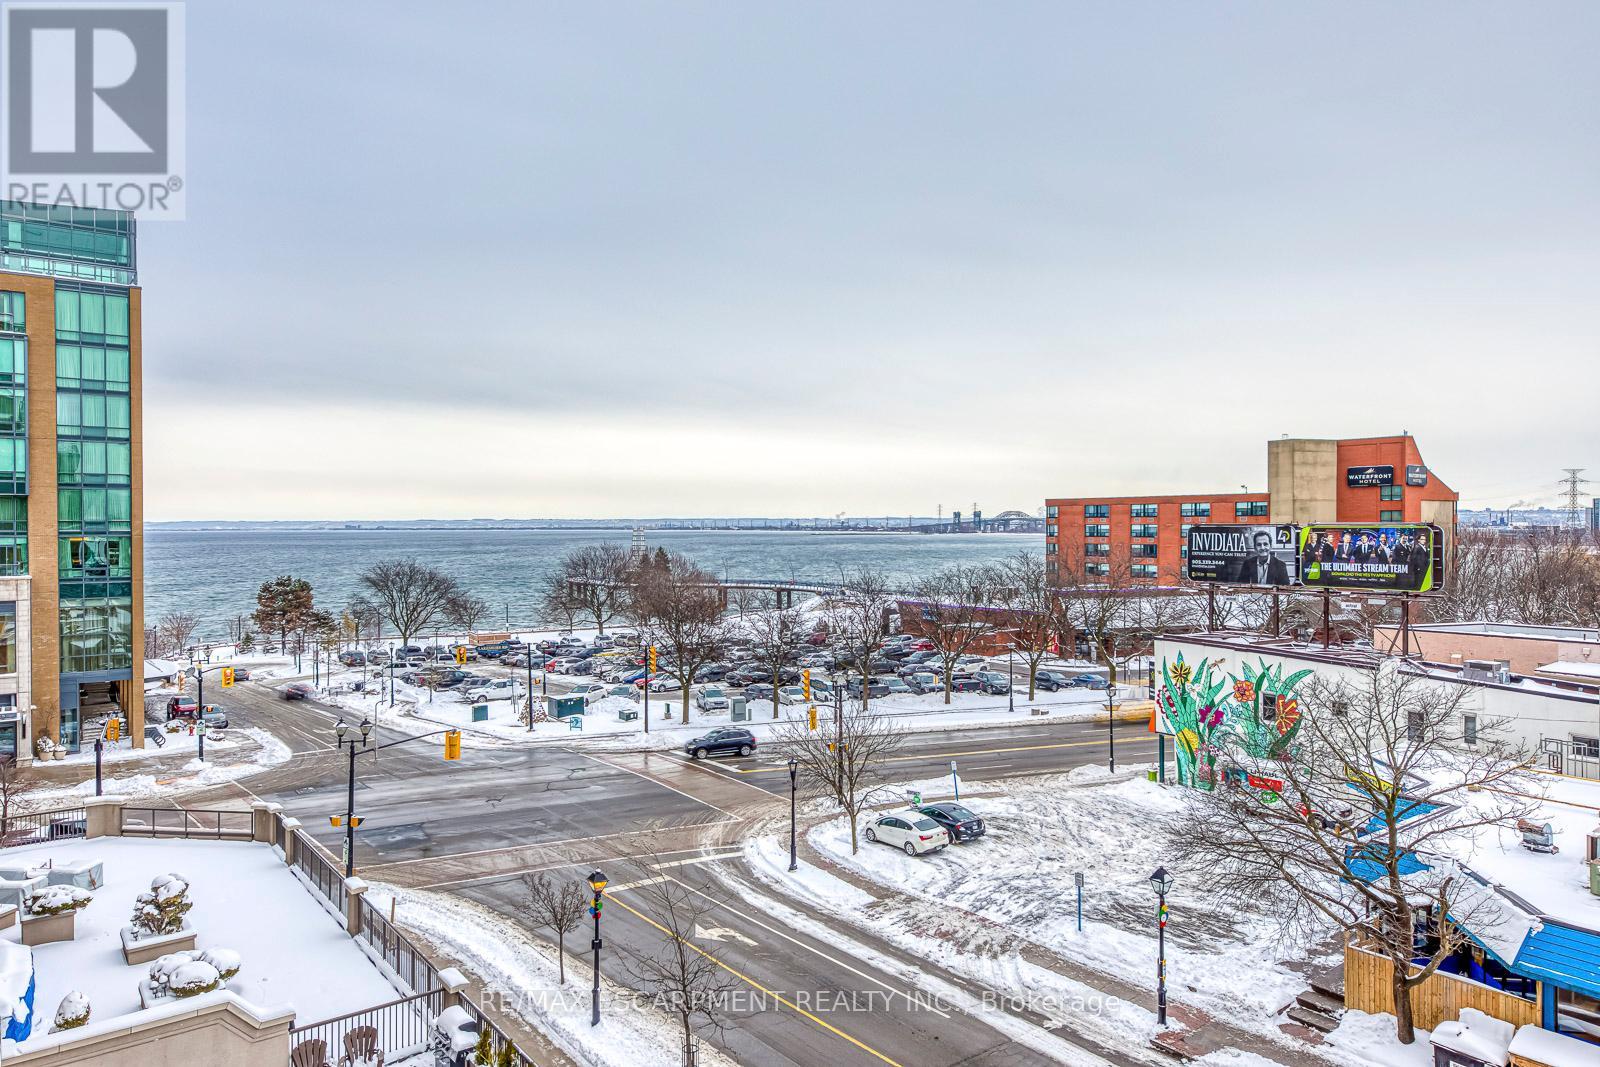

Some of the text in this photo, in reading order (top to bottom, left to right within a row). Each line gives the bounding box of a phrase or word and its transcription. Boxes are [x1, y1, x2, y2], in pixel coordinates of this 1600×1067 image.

[1192, 532, 1247, 551] INVIDIATA
[1320, 562, 1332, 571] THE
[1332, 562, 1362, 573] ULTIMATE
[1362, 563, 1390, 574] STREAM
[1390, 564, 1408, 574] TEAM
